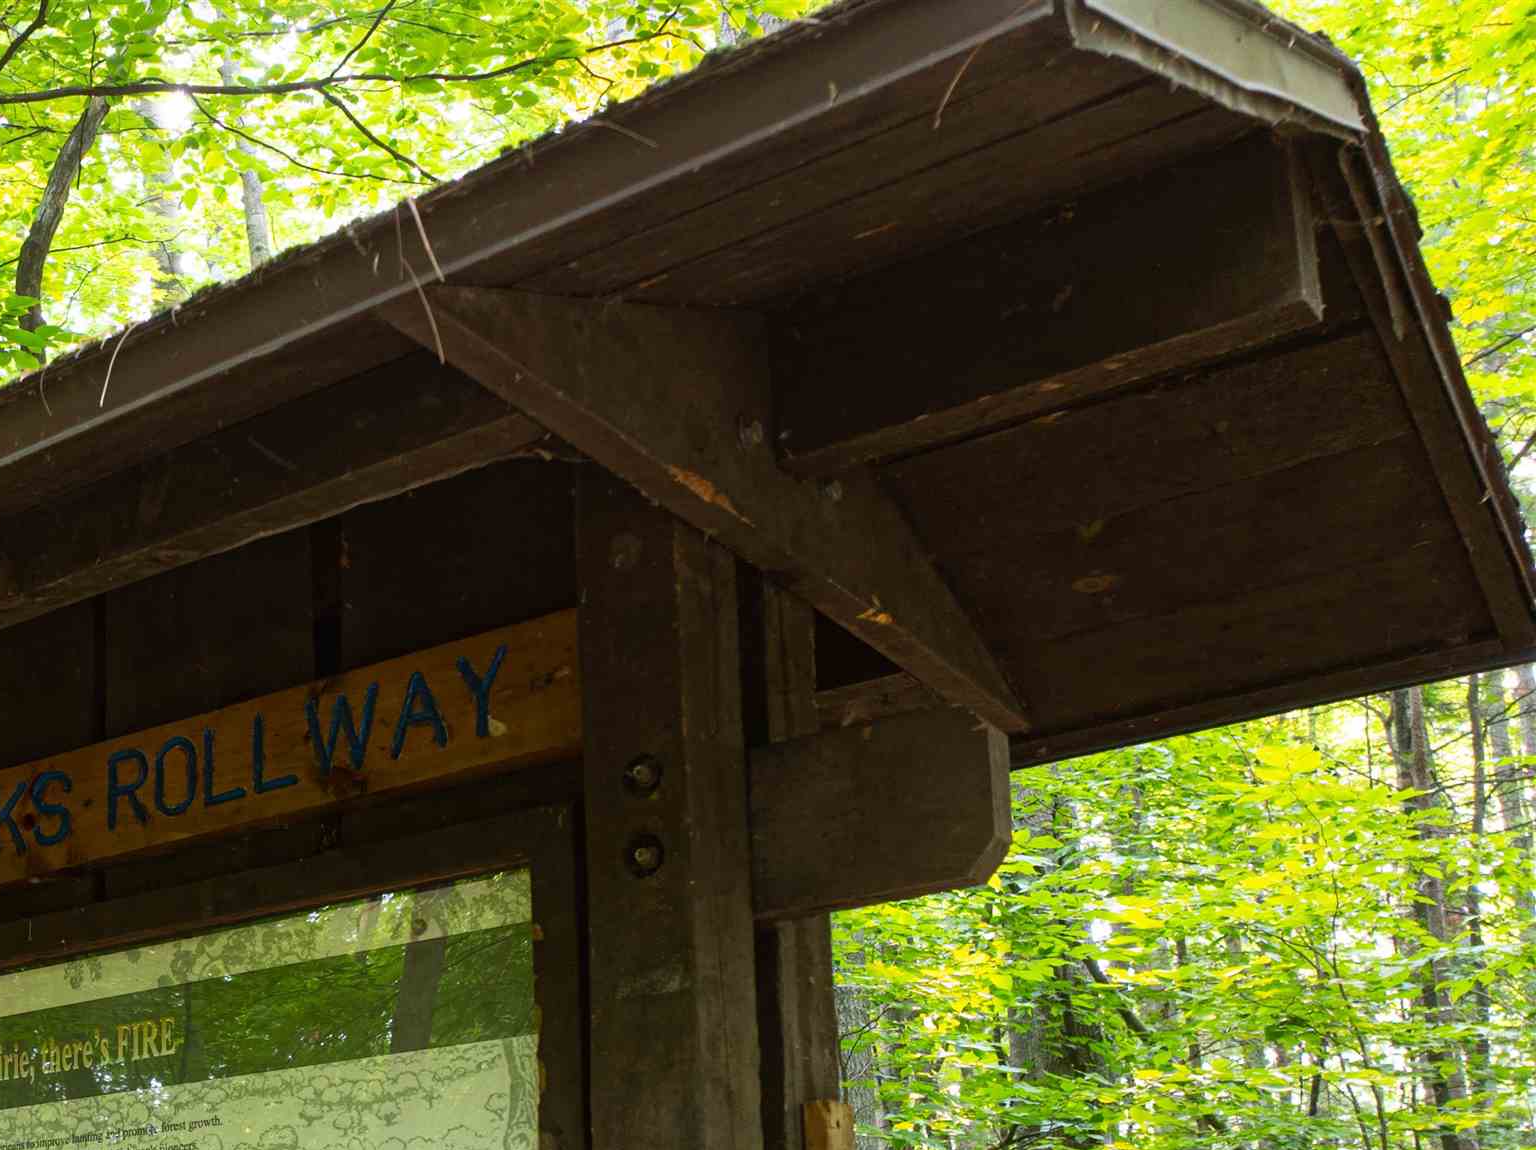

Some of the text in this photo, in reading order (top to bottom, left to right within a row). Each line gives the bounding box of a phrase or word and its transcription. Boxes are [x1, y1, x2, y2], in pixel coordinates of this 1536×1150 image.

[106, 644, 509, 832] ROLLWAY
[41, 1028, 109, 1074] there's
[117, 1018, 176, 1062] FIRE
[161, 1120, 185, 1132] forest
[188, 1115, 222, 1132] growth.
